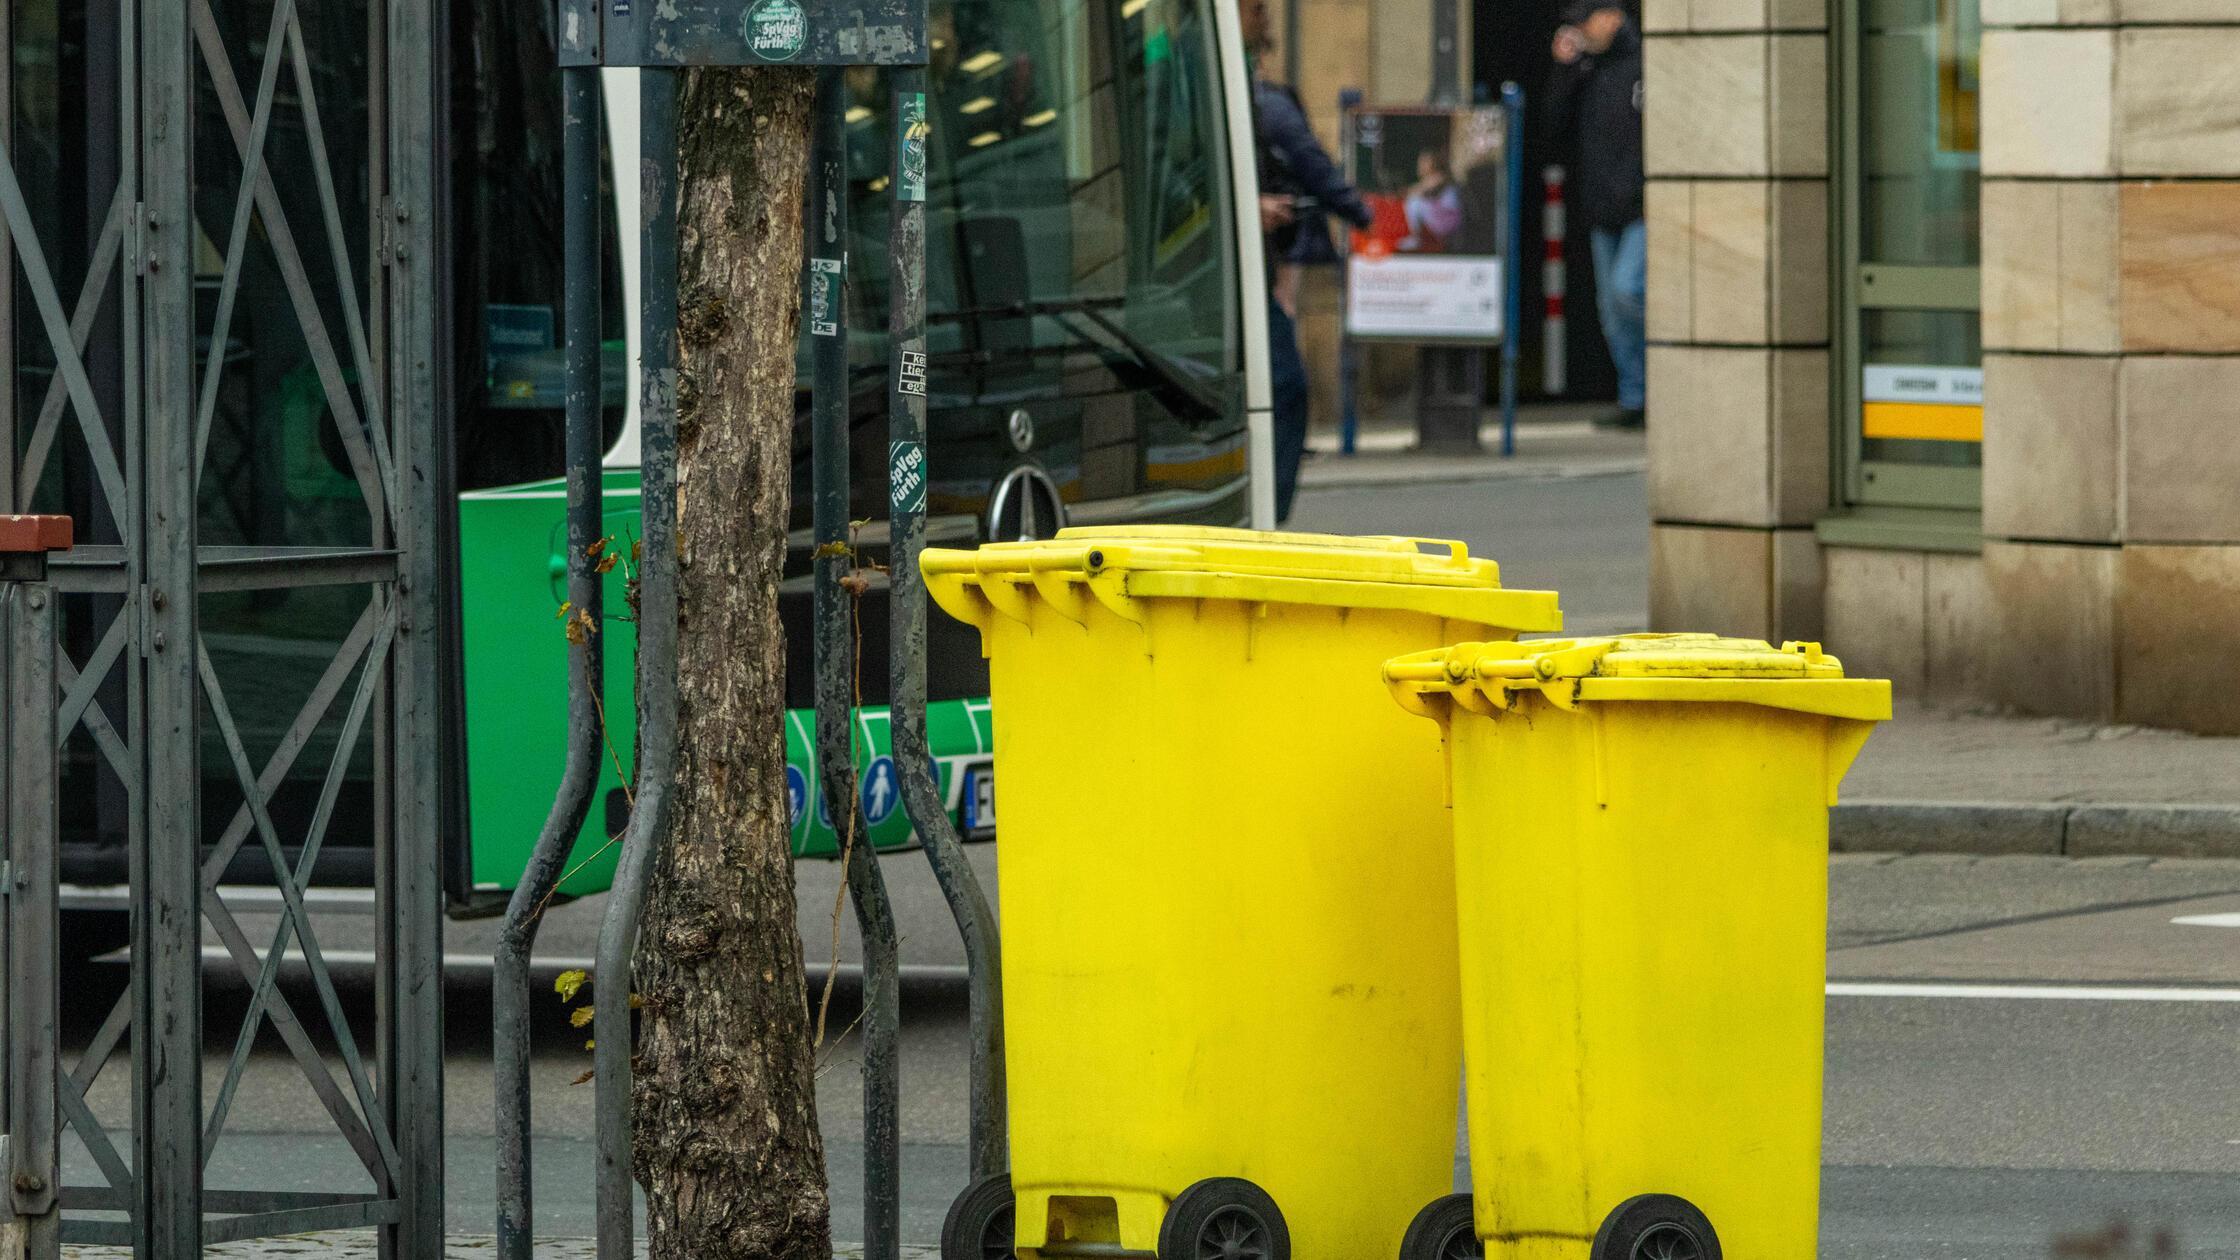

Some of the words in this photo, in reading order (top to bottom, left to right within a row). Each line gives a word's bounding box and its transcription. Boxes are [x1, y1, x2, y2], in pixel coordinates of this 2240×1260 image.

[754, 35, 785, 50] Fürth
[890, 446, 922, 486] SpVgg
[891, 471, 921, 507] Fürth
